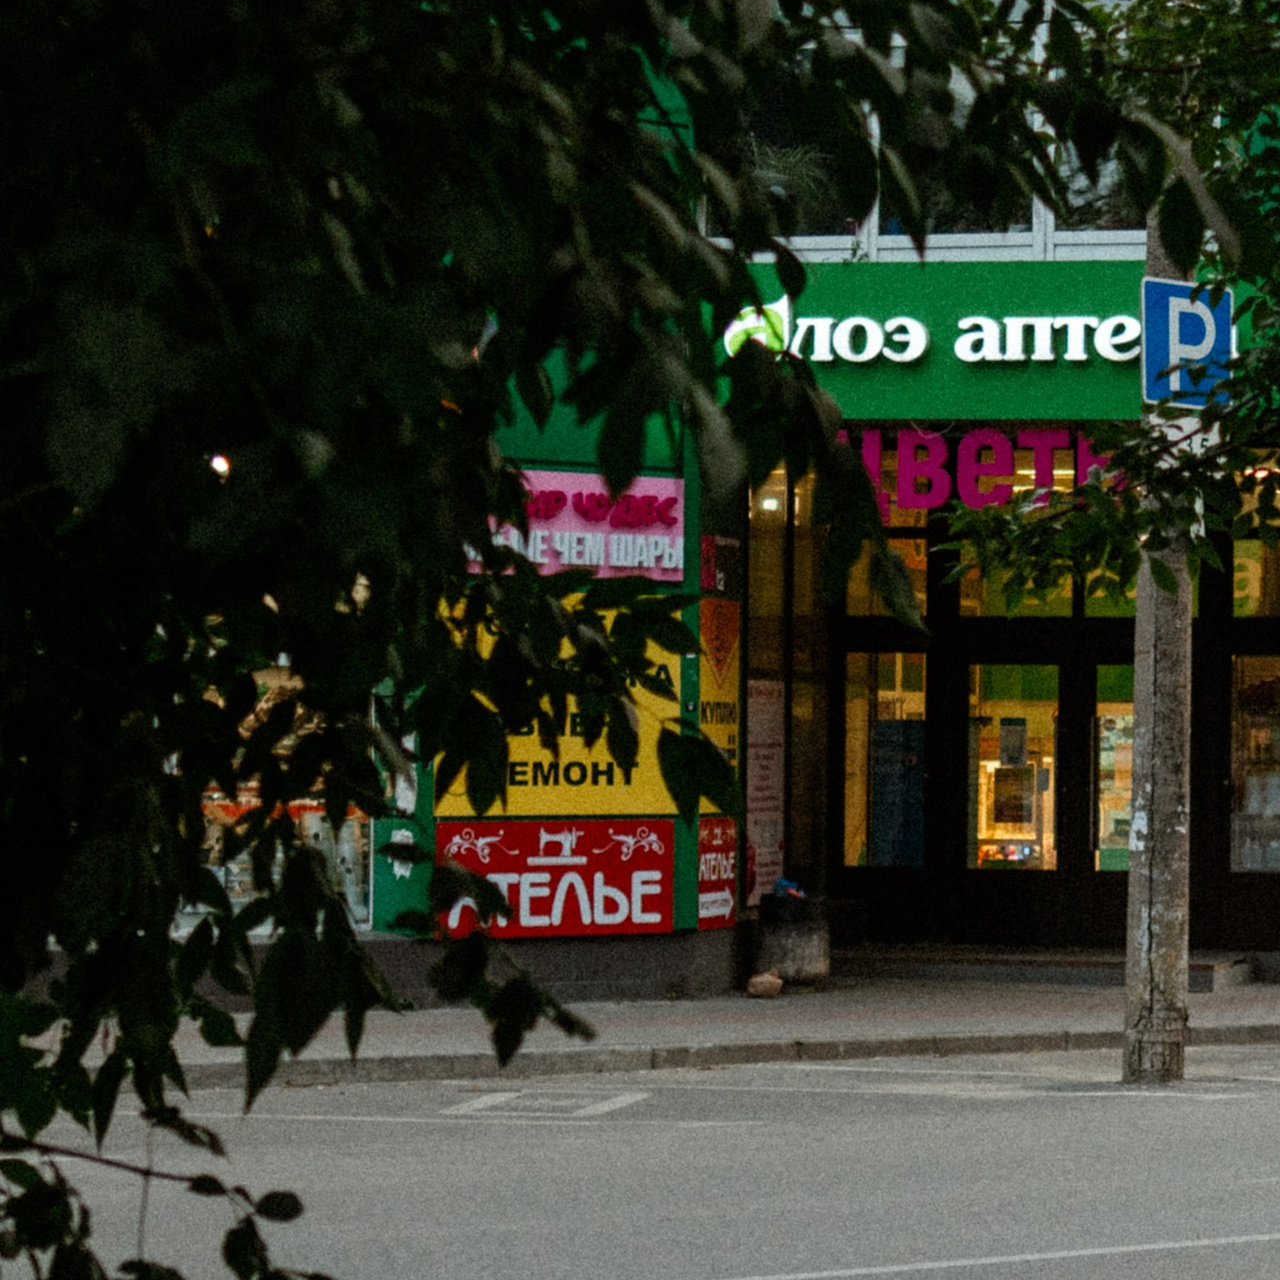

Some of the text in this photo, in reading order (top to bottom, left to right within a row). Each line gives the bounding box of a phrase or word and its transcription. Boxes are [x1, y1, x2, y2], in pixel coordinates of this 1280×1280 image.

[954, 314, 1238, 363] апте
[1168, 296, 1216, 391] P
[508, 761, 639, 786] ЕМОНТ
